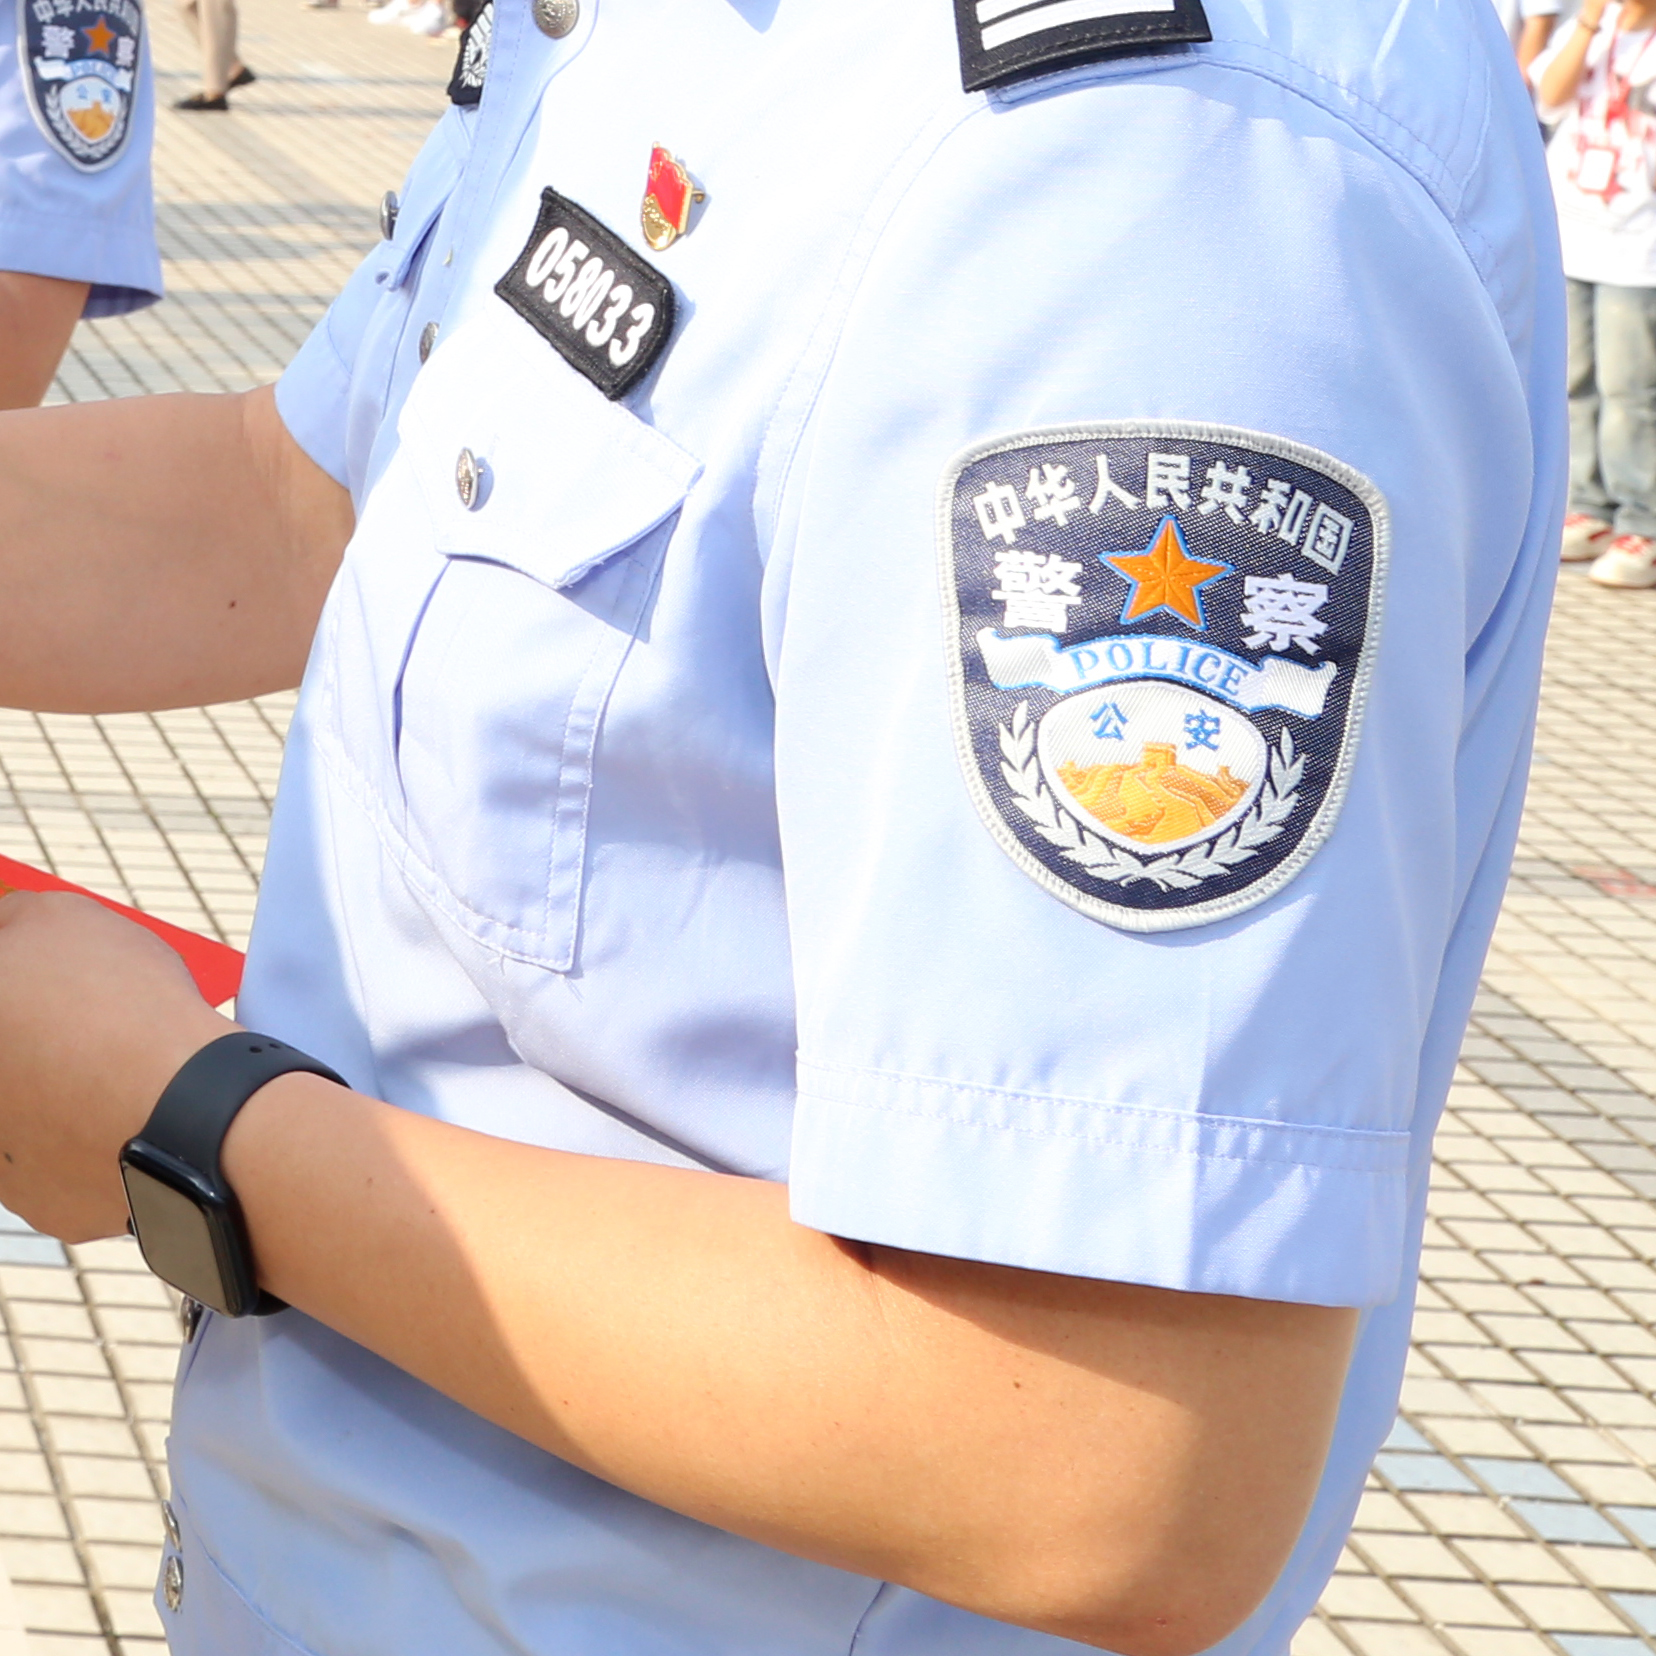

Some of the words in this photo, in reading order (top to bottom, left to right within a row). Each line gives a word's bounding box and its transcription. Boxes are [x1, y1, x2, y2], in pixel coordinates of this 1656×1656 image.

[525, 227, 656, 368] 058033
[972, 451, 1355, 575] 中华人民共和国
[1070, 641, 1254, 697] POLICE
